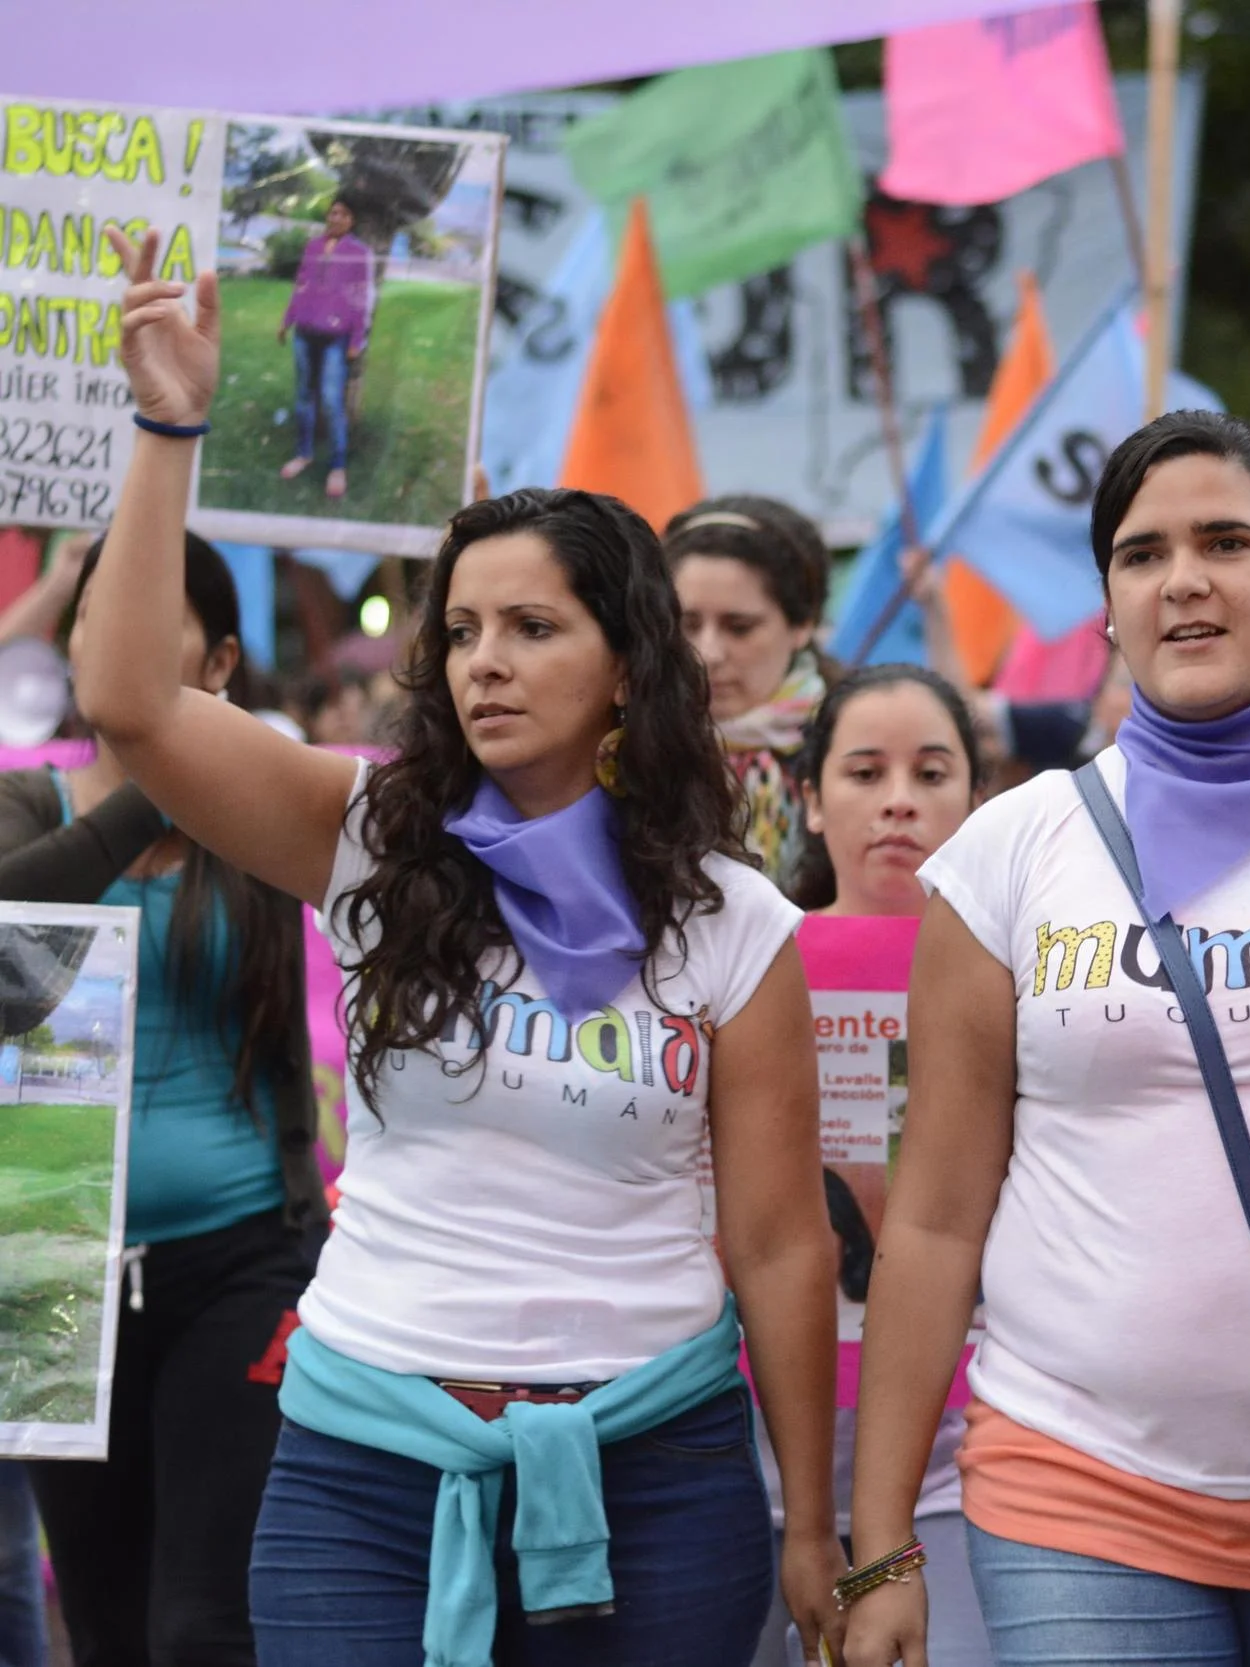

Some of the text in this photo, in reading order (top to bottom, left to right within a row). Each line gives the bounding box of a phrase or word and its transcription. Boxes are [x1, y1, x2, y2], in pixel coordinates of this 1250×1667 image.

[4, 104, 165, 185] BUSCA
[0, 205, 154, 281] DANOS
[0, 470, 114, 523] 79692
[365, 976, 700, 1097] mala
[388, 1051, 678, 1126] UCUMÁN
[820, 1132, 883, 1146] eviento
